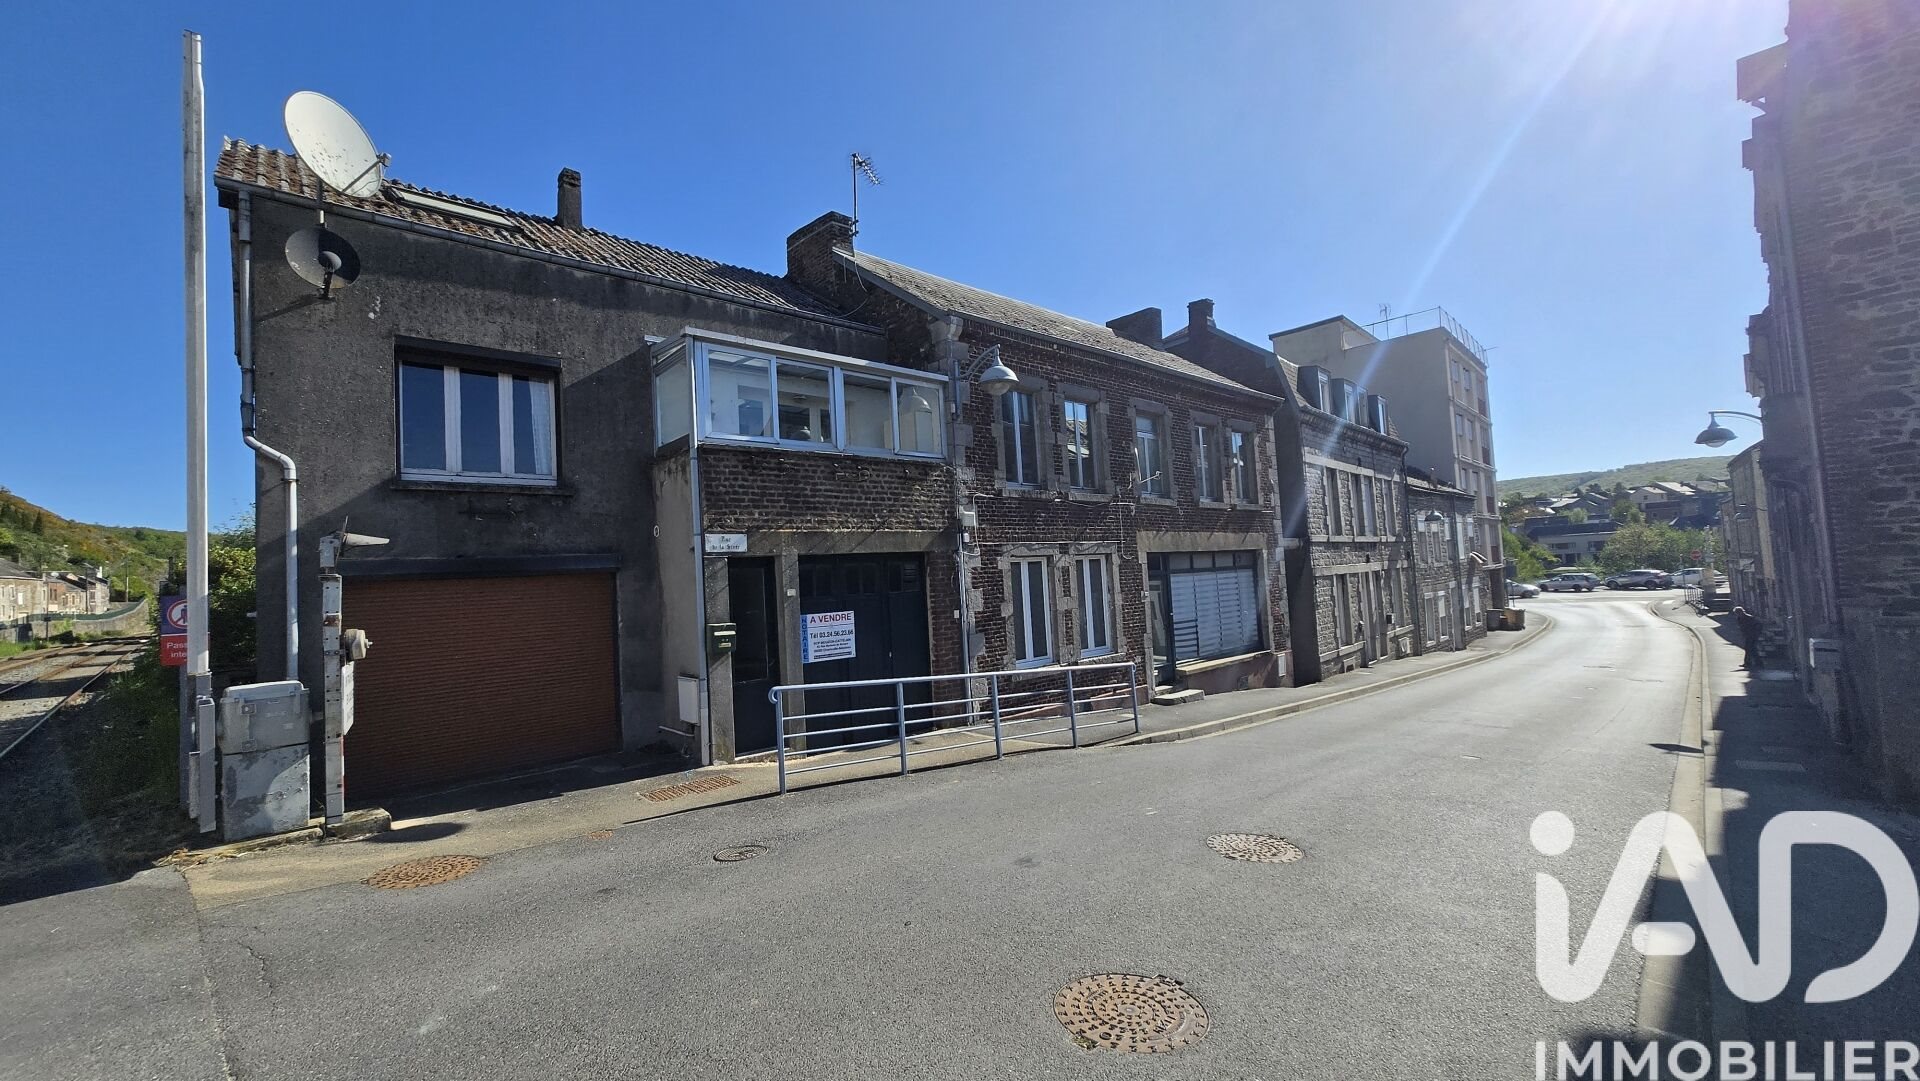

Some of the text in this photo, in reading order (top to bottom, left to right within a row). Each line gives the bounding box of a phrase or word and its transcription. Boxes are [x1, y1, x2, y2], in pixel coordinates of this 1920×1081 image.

[810, 612, 852, 624] A VENDRE
[801, 617, 809, 660] NOTAIRE
